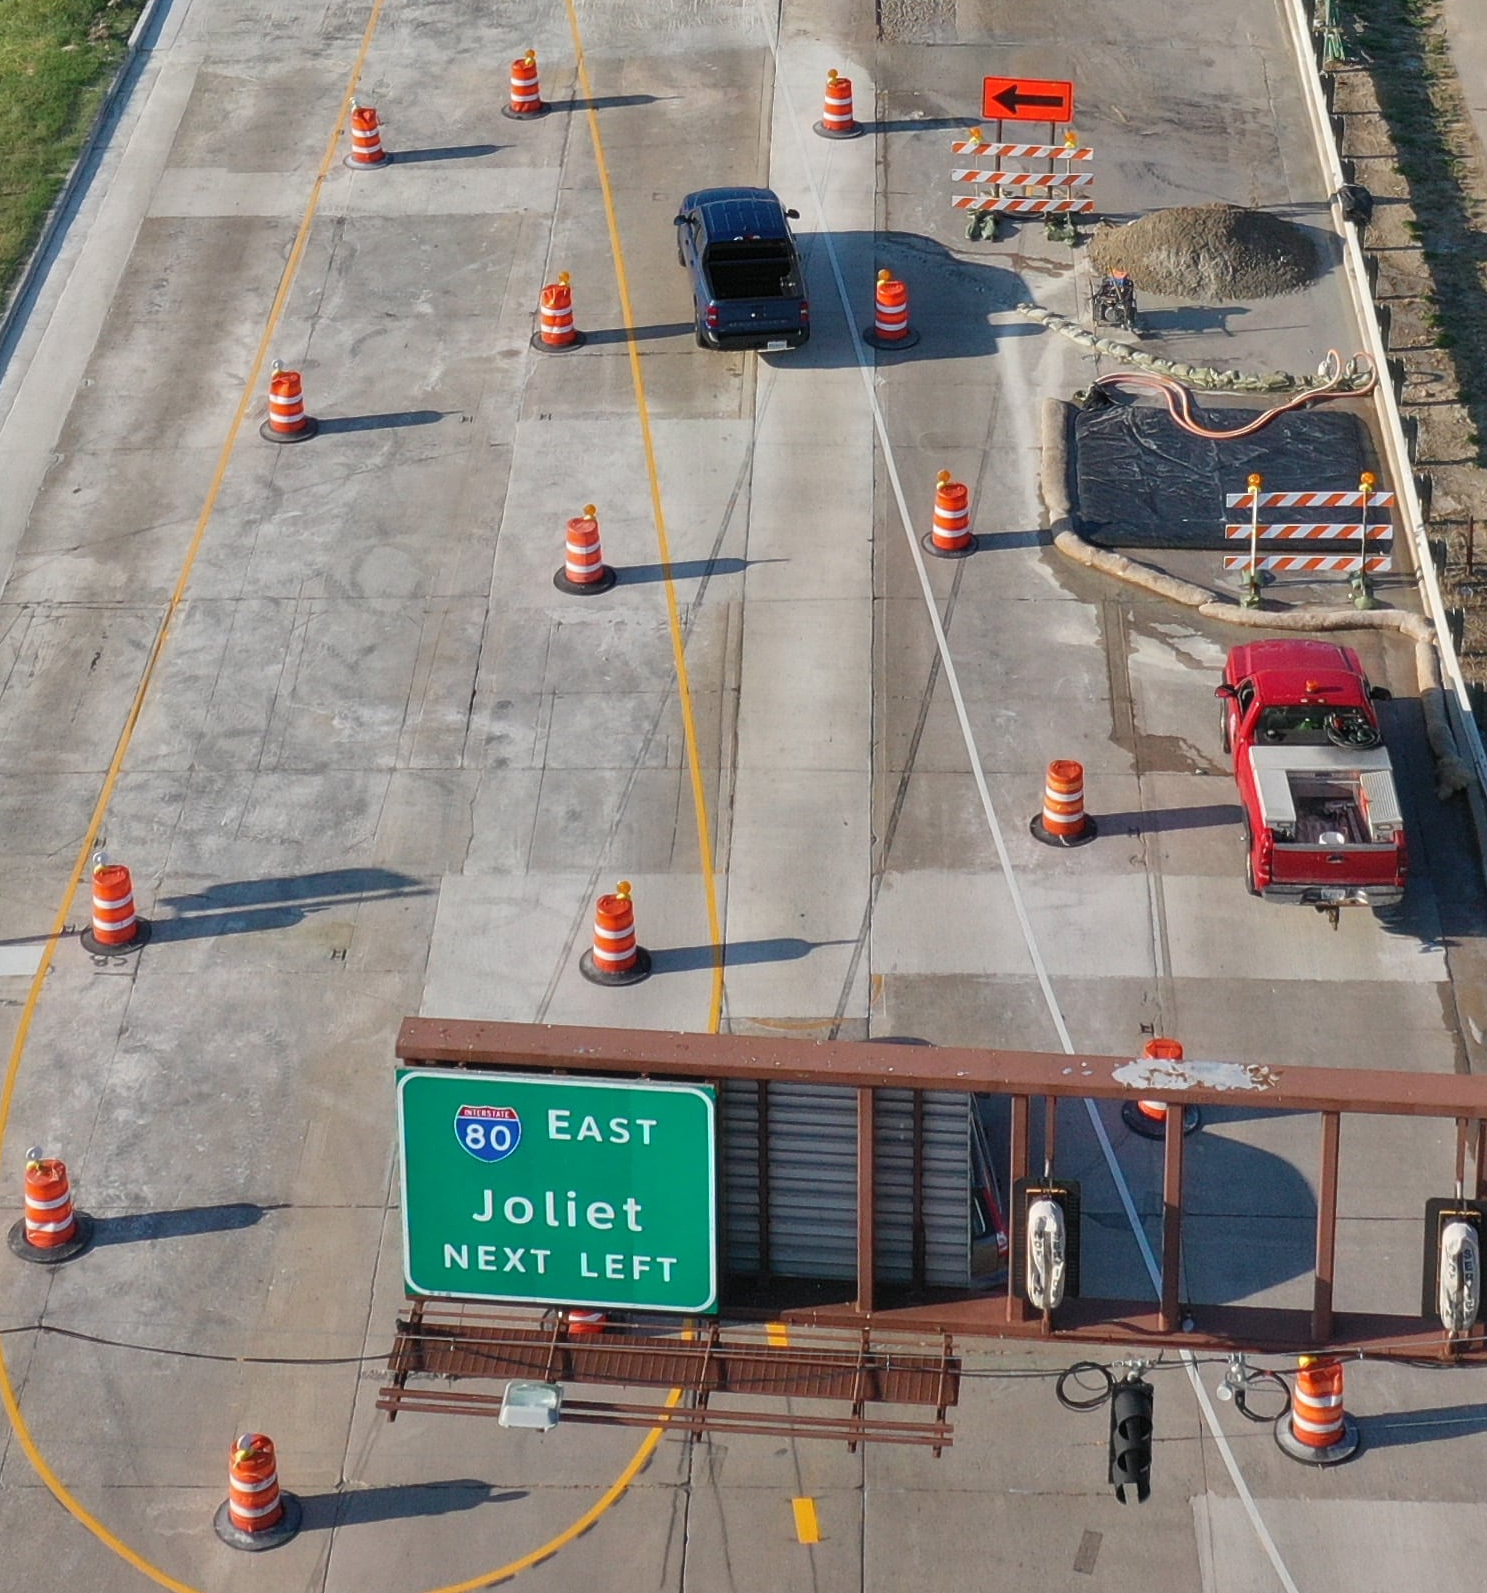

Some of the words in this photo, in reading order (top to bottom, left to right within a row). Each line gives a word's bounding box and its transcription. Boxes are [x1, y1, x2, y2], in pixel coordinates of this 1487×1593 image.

[464, 1109, 510, 1118] INTERSTATE
[465, 1123, 511, 1151] 80
[547, 1109, 657, 1145] EAST
[472, 1189, 643, 1232] Joliet
[443, 1243, 551, 1274] NEXT
[580, 1252, 678, 1282] LEFT
